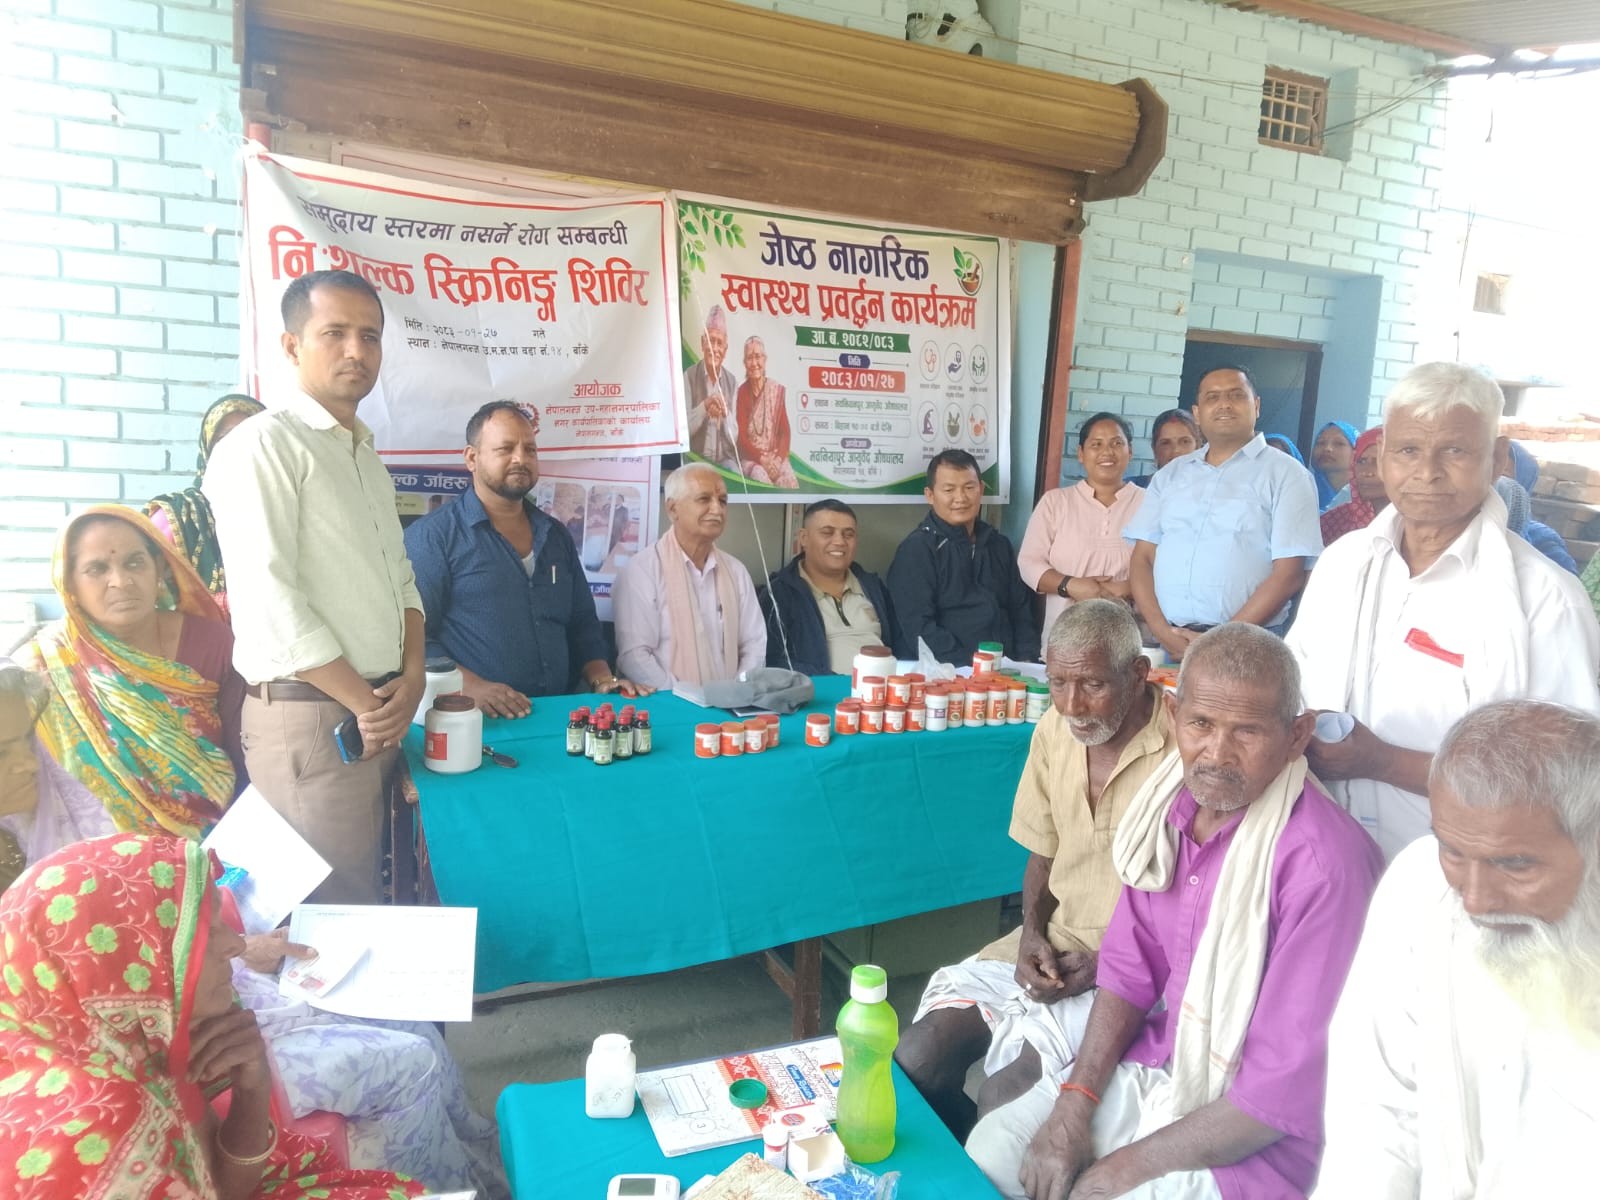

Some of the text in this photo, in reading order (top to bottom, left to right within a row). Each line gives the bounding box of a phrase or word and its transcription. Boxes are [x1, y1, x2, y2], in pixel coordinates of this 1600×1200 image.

[297, 196, 628, 246] समुदाय स्तरमा नसर्ने रोग सम्बन्धी
[759, 221, 930, 281] जेष्ठ नागरिक
[567, 257, 650, 306] शिविर
[720, 273, 810, 316] स्वास्थ्य
[890, 284, 978, 329] कार्यक्रम
[404, 316, 423, 330] मिति
[407, 338, 430, 349] स्थान
[842, 333, 895, 350] २०८२/०८३
[574, 379, 622, 397] आयोजक
[821, 370, 896, 389] २०८३/०१/२७
